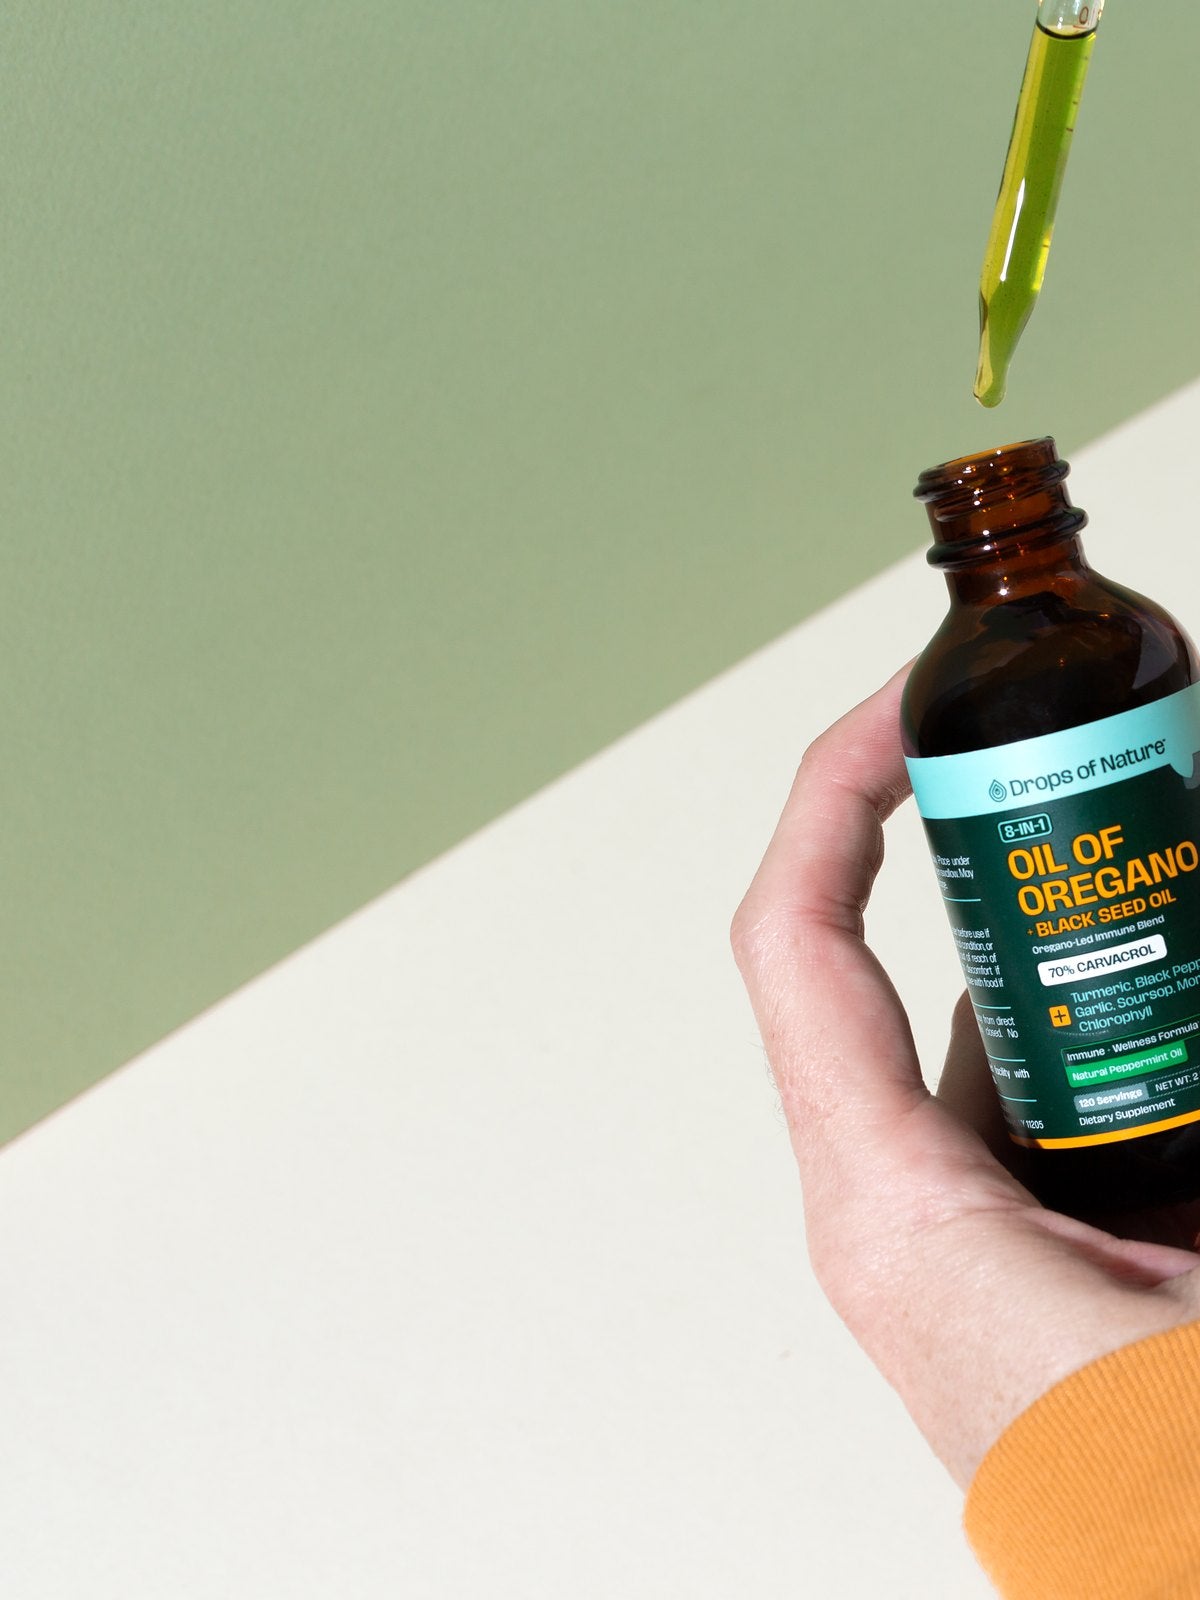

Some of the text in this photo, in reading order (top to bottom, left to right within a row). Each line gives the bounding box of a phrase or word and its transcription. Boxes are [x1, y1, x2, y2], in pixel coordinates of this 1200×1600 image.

[1009, 740, 1166, 797] Drops of Nature
[1004, 818, 1046, 838] 8-IN-1
[951, 856, 970, 866] under
[1007, 825, 1124, 881] OIL OF
[1017, 841, 1199, 916] OREGANO
[1036, 911, 1096, 938] BLACK
[1098, 898, 1146, 923] SEED
[1150, 888, 1177, 908] OIL
[974, 930, 985, 939] use
[984, 928, 990, 938] if
[1032, 914, 1165, 955] Oregano-Led Immune Blend
[986, 942, 993, 951] or
[989, 953, 997, 963] of
[1048, 944, 1157, 979] 70% CARVACROL
[995, 965, 1000, 975] if
[1135, 969, 1171, 988] Black
[984, 977, 999, 988] food
[998, 977, 1004, 987] if
[996, 1016, 1015, 1026] direct
[1079, 1005, 1153, 1032] Chlorophyll
[1007, 1028, 1019, 1038] No
[1067, 1022, 1199, 1061] Immune Wellness Formula
[1014, 1069, 1030, 1078] with
[1072, 1047, 1183, 1081] Natural Peppermint Oil
[1079, 1098, 1095, 1107] 120
[1097, 1088, 1143, 1106] Servings
[1155, 1080, 1173, 1091] NET
[1192, 1072, 1199, 1081] 2
[1079, 1098, 1176, 1126] Dietary Supplement
[1026, 1119, 1044, 1129] 11205
